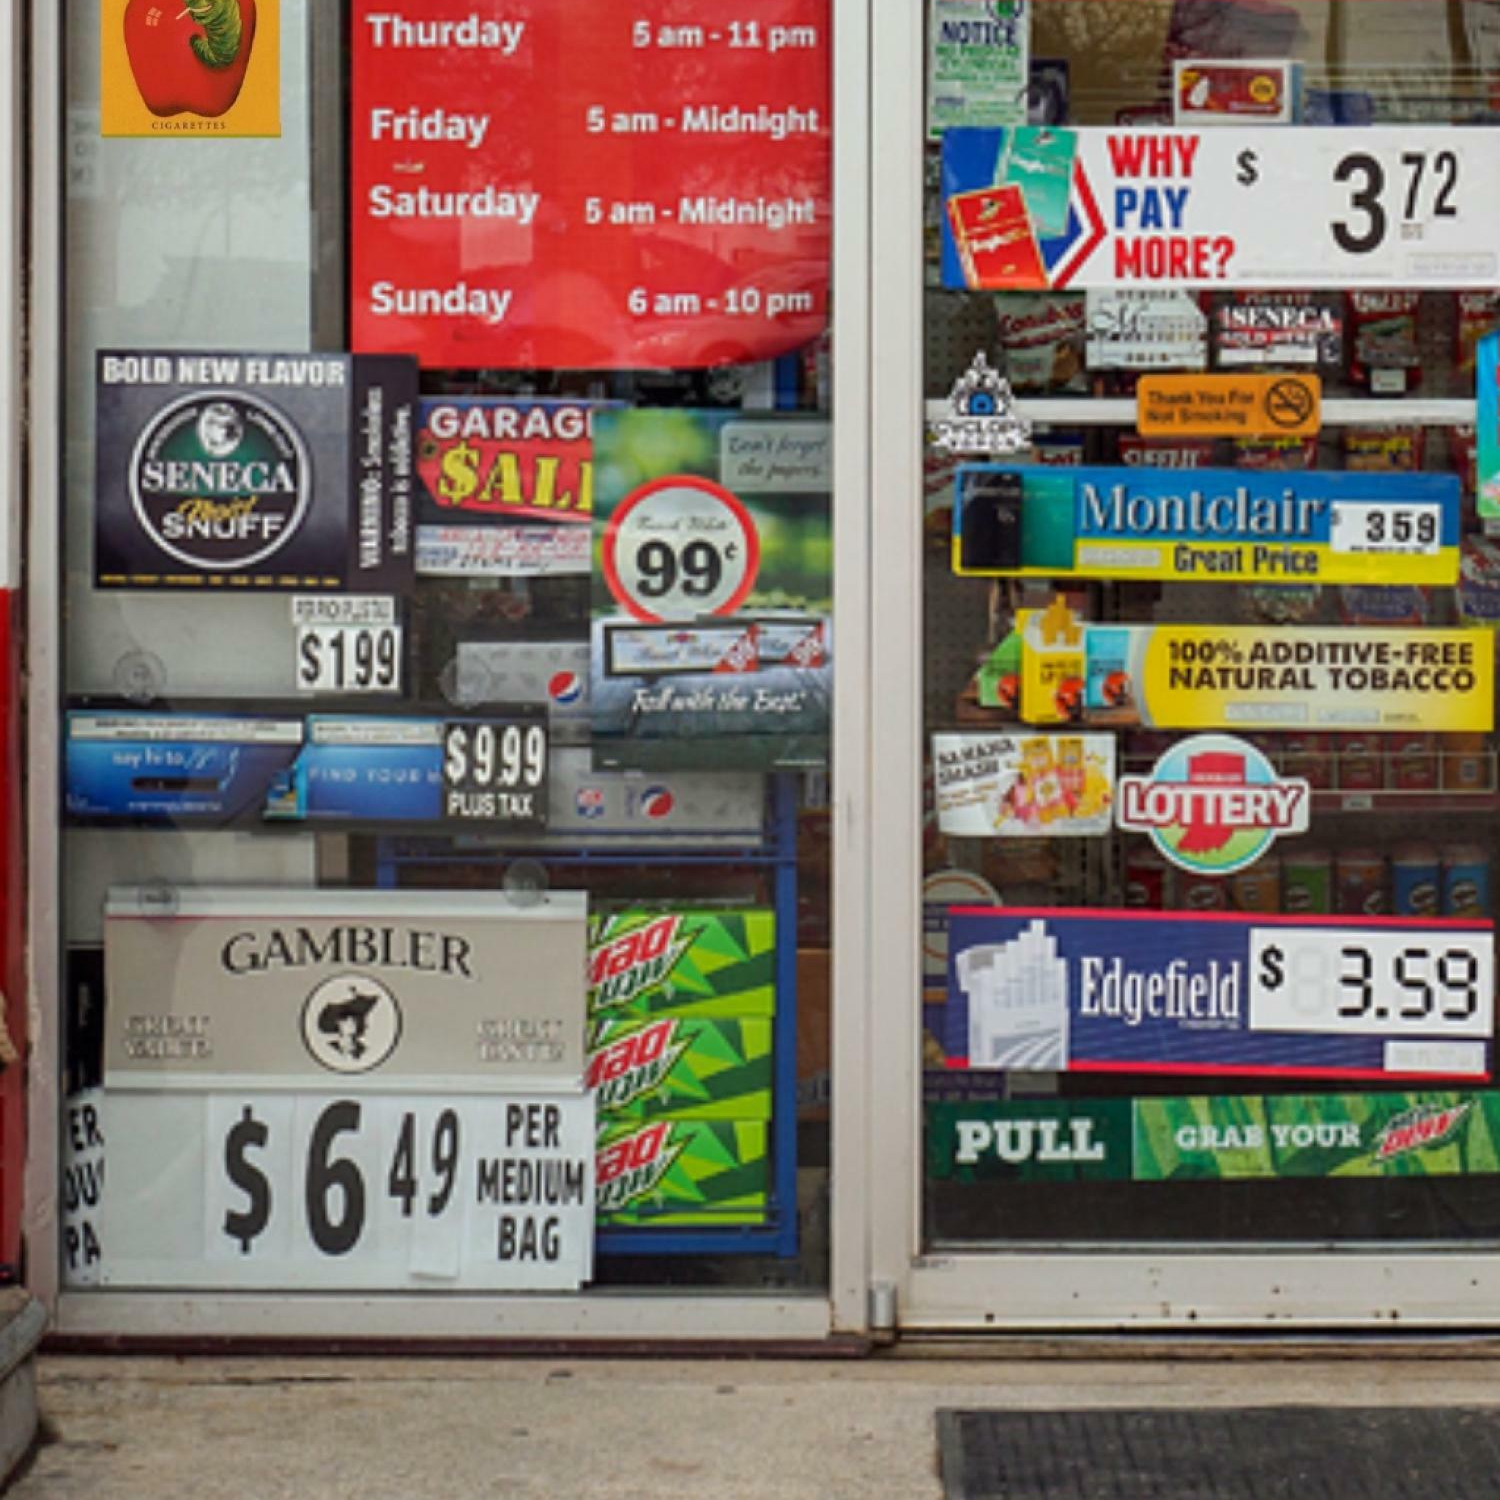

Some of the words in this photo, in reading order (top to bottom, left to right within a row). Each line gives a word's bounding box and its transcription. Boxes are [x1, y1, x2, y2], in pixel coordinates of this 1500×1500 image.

[367, 15, 525, 56] Thurday
[151, 121, 227, 131] CIGARETTES
[371, 108, 489, 148] Friday
[682, 106, 818, 140] Midnight
[1106, 134, 1200, 178] WHY
[1237, 150, 1259, 186] $
[370, 185, 540, 227] Saturday
[679, 197, 815, 231] Midnight
[1114, 187, 1191, 229] PAY
[1113, 235, 1236, 280] MORE?
[371, 282, 513, 324] Sunday
[1226, 306, 1335, 329] SENECA
[102, 355, 173, 385] BOLD
[178, 355, 240, 385] NEW
[245, 355, 345, 385] FLAVOR
[429, 406, 592, 440] GARAG
[141, 460, 296, 494] SENECA
[161, 511, 286, 540] SNUFF
[1080, 483, 1323, 537] Montclair
[1174, 544, 1245, 574] Great
[1252, 545, 1319, 574] Price
[1168, 640, 1243, 665] 100%
[1248, 640, 1474, 667] ADDITIVE-FREE
[1168, 667, 1318, 692] NATURAL
[1329, 667, 1477, 693] TOBACCO
[308, 767, 358, 781] FIND
[366, 767, 420, 781] YOUR
[447, 792, 496, 817] PLUS
[497, 792, 534, 817] TAX
[1125, 784, 1304, 825] LOTTERY
[221, 925, 473, 977] GAMBLER
[1080, 956, 1240, 1026] Edgefield
[1259, 945, 1285, 990] $
[1338, 947, 1479, 1021] 3.59
[504, 1103, 562, 1149] PER
[955, 1119, 1105, 1164] PULL
[1175, 1125, 1265, 1150] GRAB
[1271, 1124, 1363, 1149] YOUR
[475, 1159, 586, 1206] MEDIUM
[498, 1216, 563, 1261] BAG
